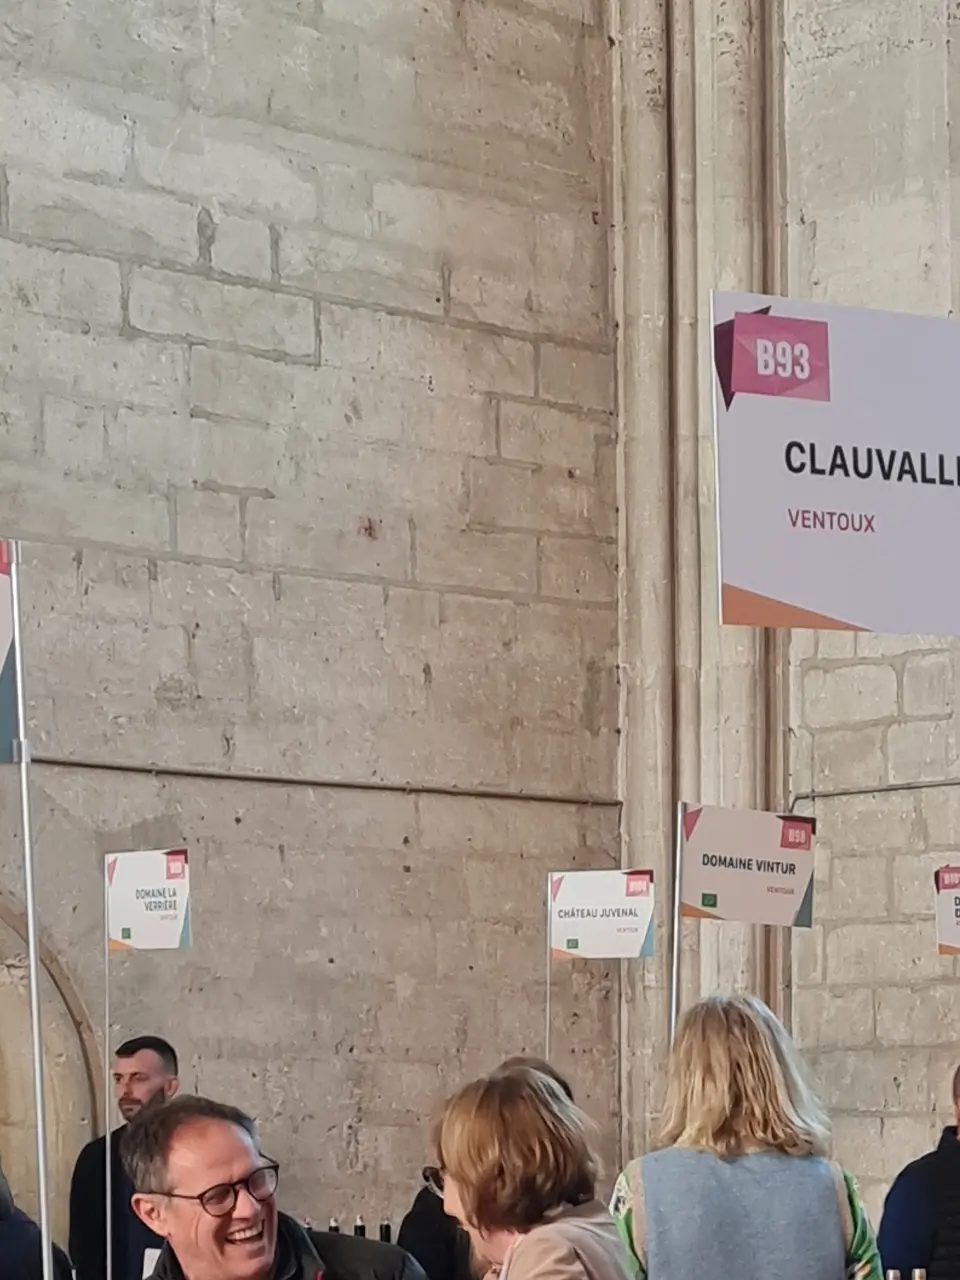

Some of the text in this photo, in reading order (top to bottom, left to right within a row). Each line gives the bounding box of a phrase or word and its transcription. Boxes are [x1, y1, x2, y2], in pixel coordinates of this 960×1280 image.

[755, 338, 811, 380] B93
[787, 508, 876, 533] VENTOUX
[702, 853, 796, 875] DOMAINE VINTUR
[135, 887, 177, 900] DOMAINE LA
[558, 906, 639, 918] CHÂTEAU JUVENAL
